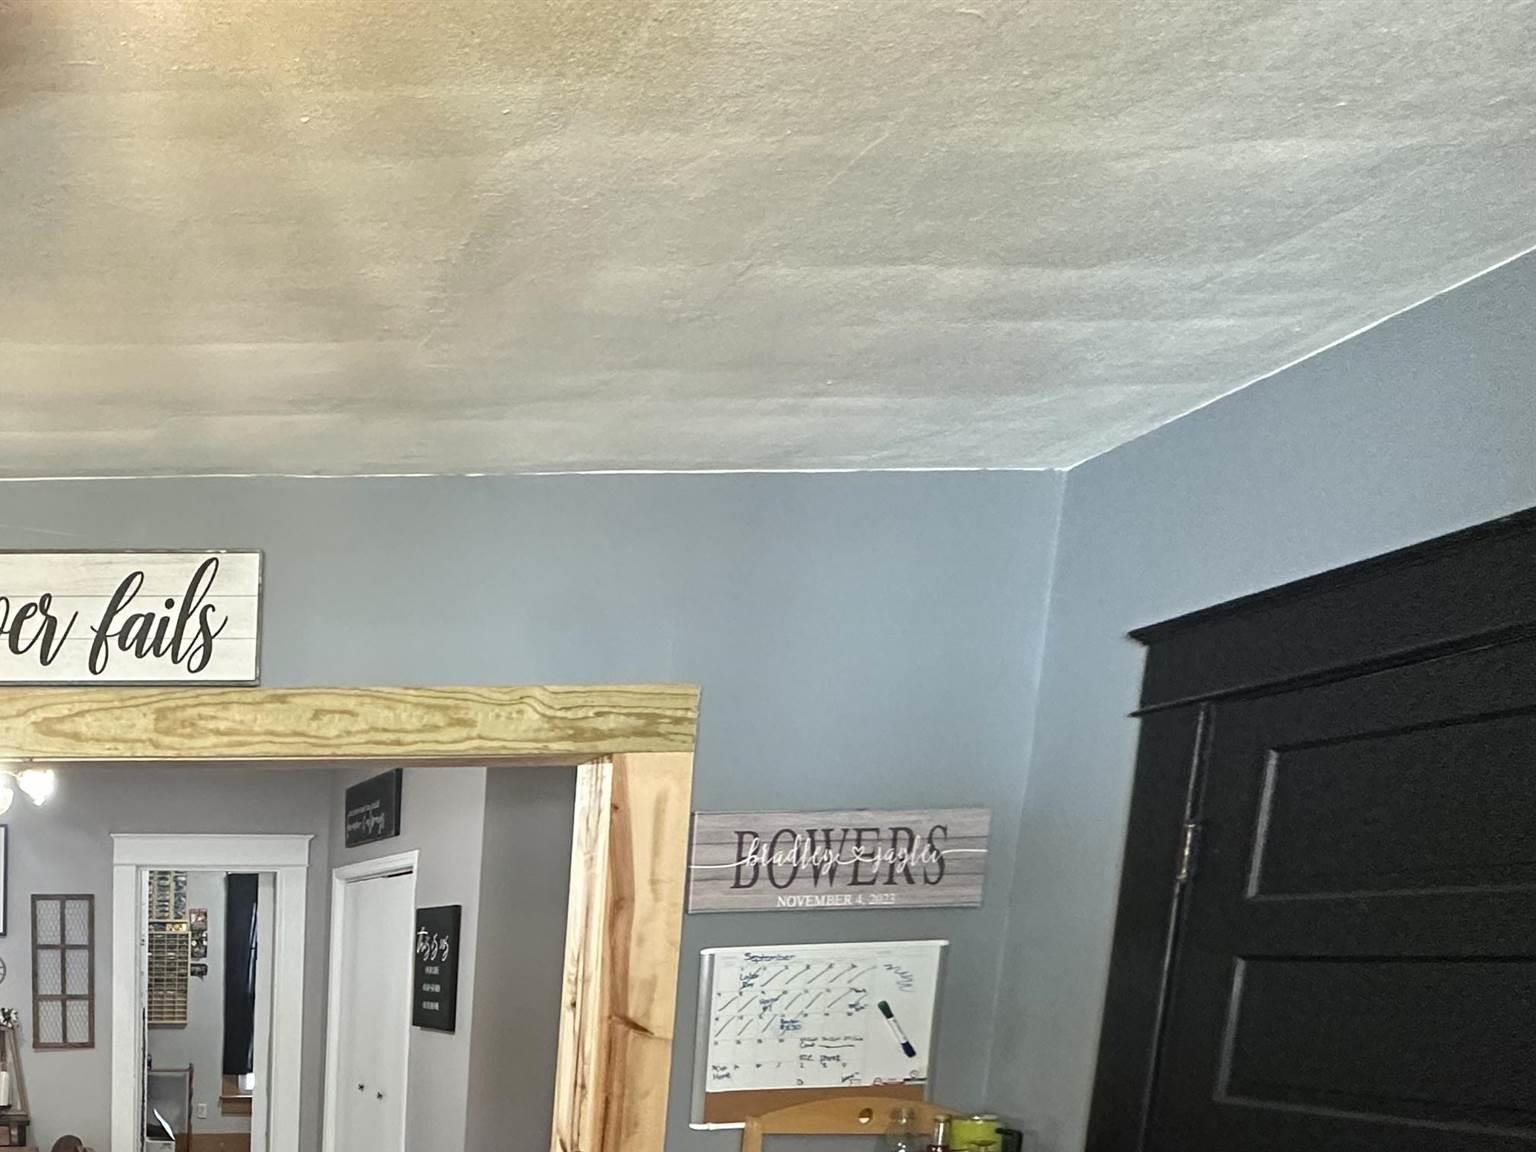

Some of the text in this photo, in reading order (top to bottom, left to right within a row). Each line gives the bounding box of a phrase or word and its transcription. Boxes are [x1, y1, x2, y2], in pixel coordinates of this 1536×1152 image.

[88, 556, 229, 676] fails
[730, 824, 948, 889] BOWERS
[776, 894, 853, 908] NOVEMBER
